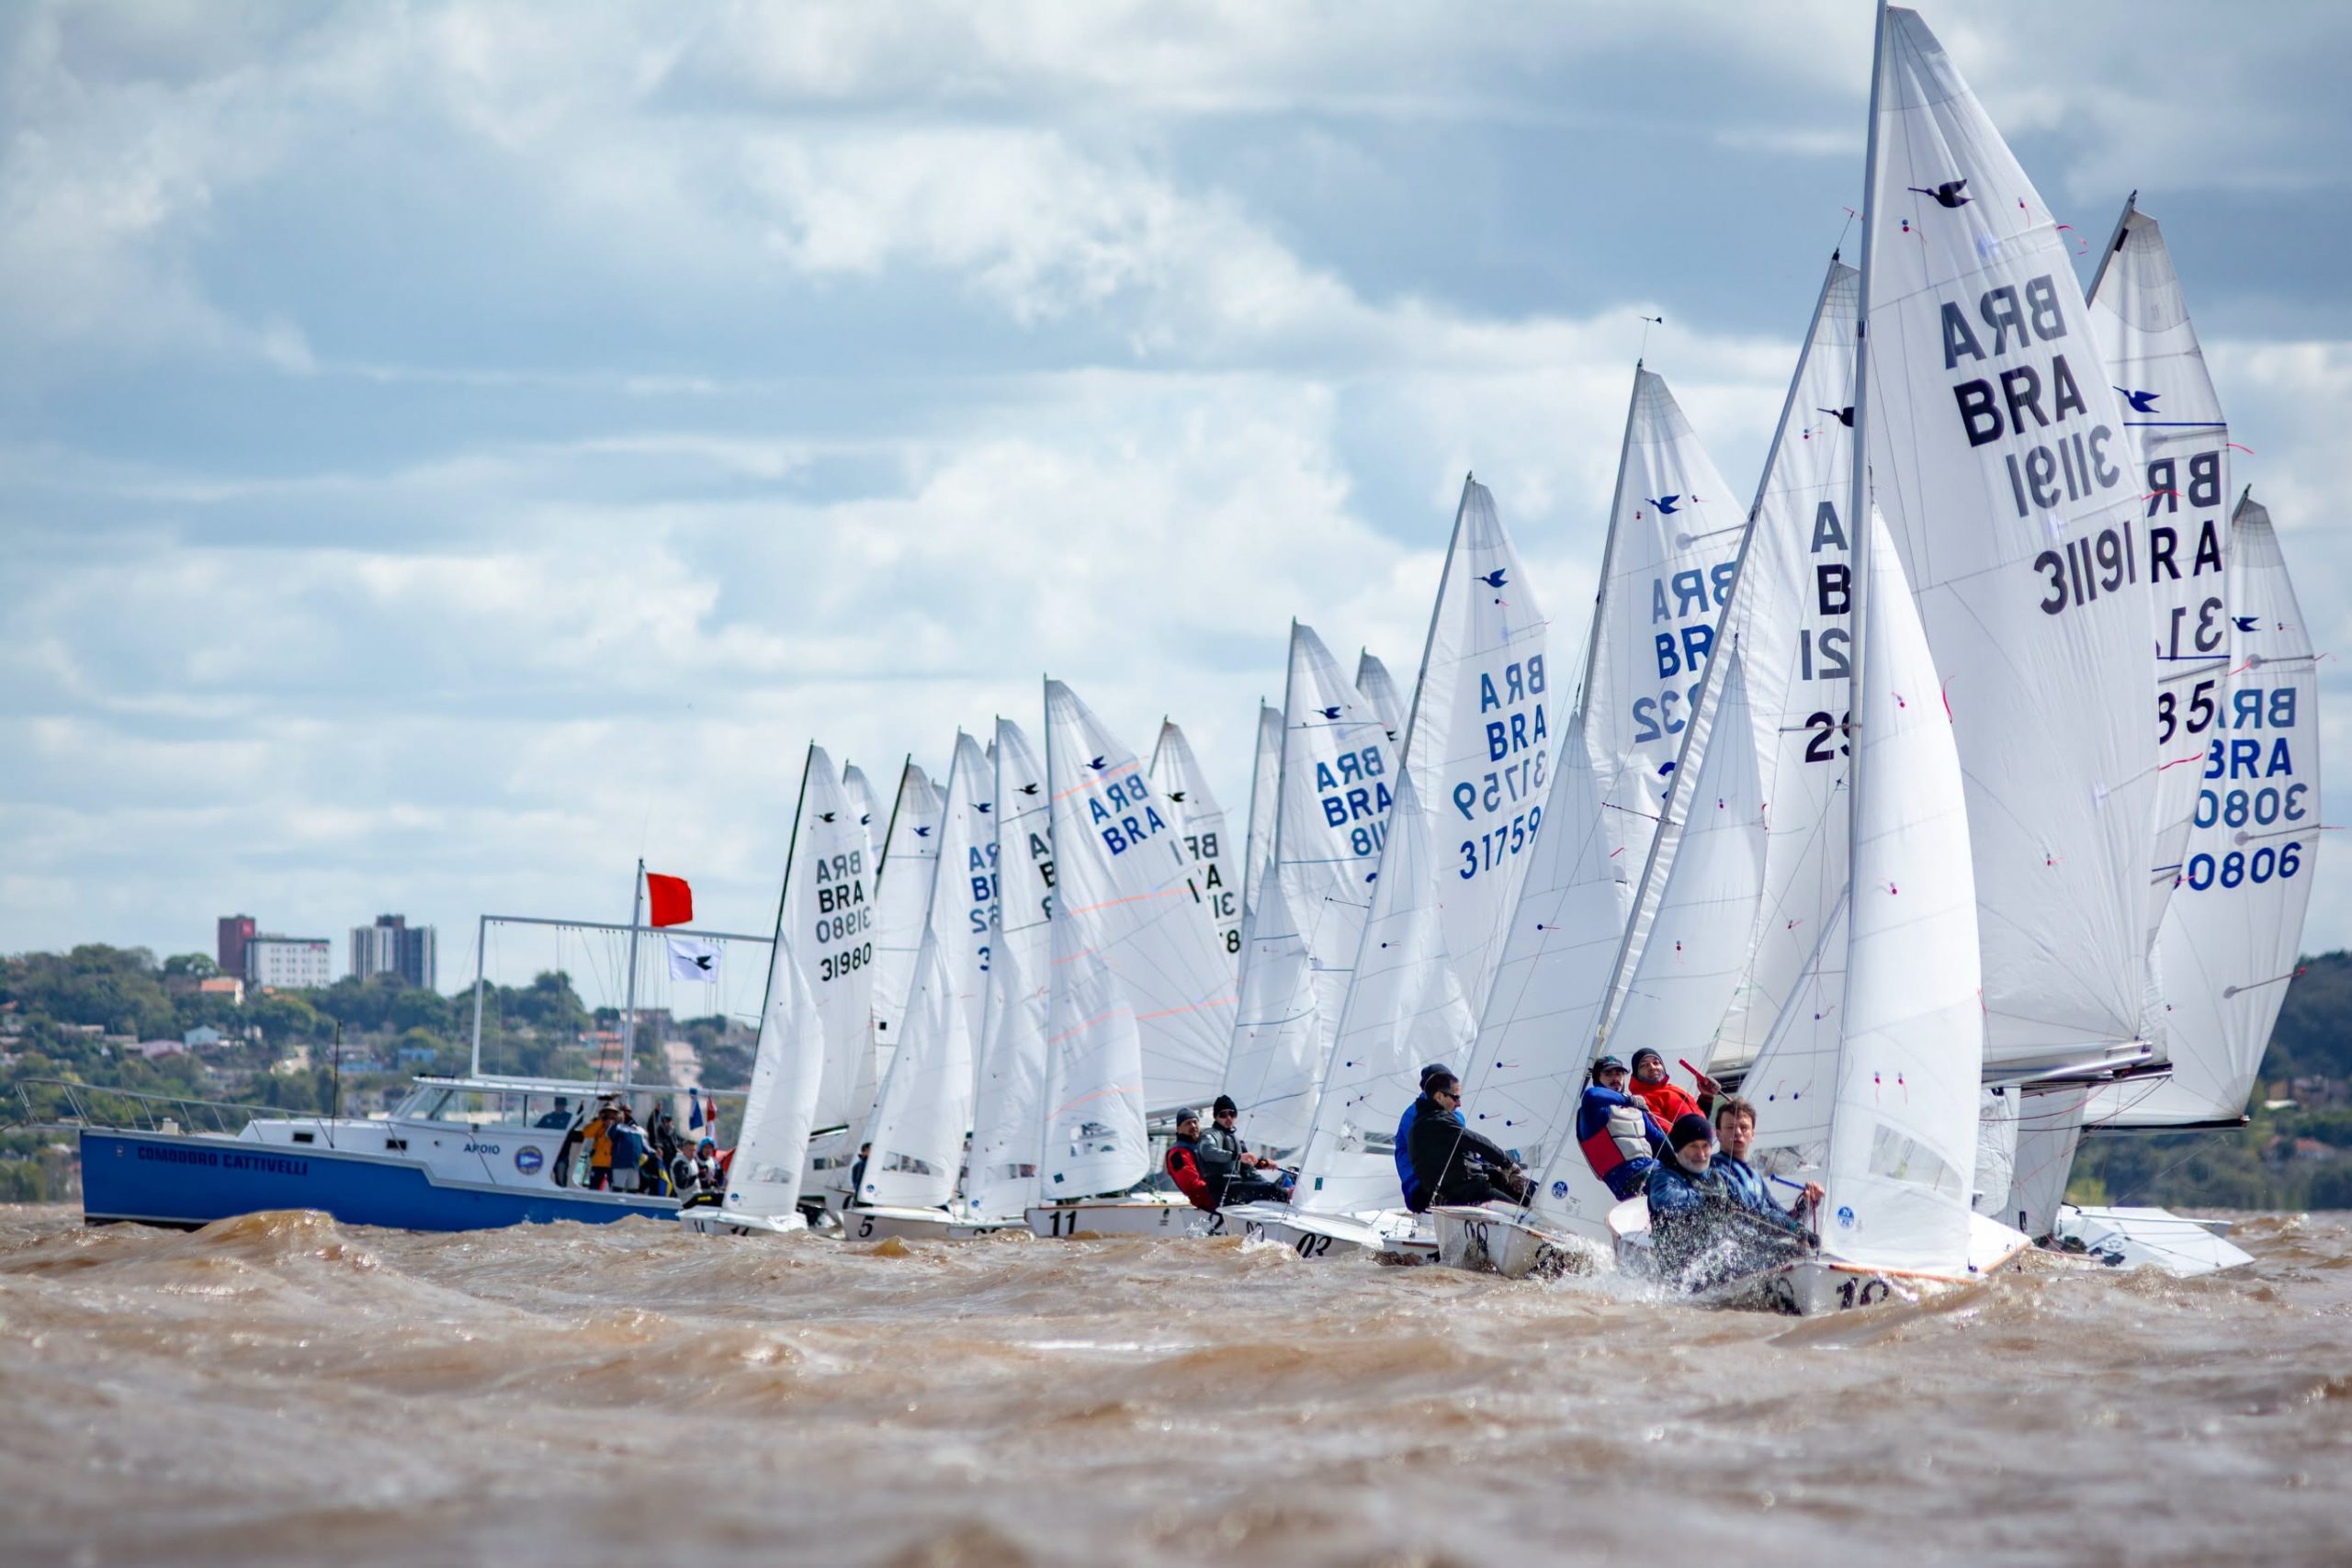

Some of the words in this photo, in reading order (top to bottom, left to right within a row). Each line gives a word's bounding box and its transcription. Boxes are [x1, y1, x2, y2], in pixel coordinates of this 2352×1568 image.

[1953, 354, 2087, 447] BRA
[2033, 521, 2137, 615] 31191
[1486, 704, 1547, 762] BRA
[1321, 782, 1394, 828] BRA
[1102, 806, 1166, 855] BRA
[1459, 806, 1542, 880] 31759
[818, 880, 865, 914] BRA
[820, 942, 872, 982] 31980
[139, 1145, 218, 1168] COMODORO
[223, 1154, 308, 1176] CATTIVELLI
[463, 1143, 501, 1155] APOIO
[859, 1215, 875, 1237] 5
[1049, 1210, 1077, 1237] 11
[1837, 1277, 1890, 1311] 10
